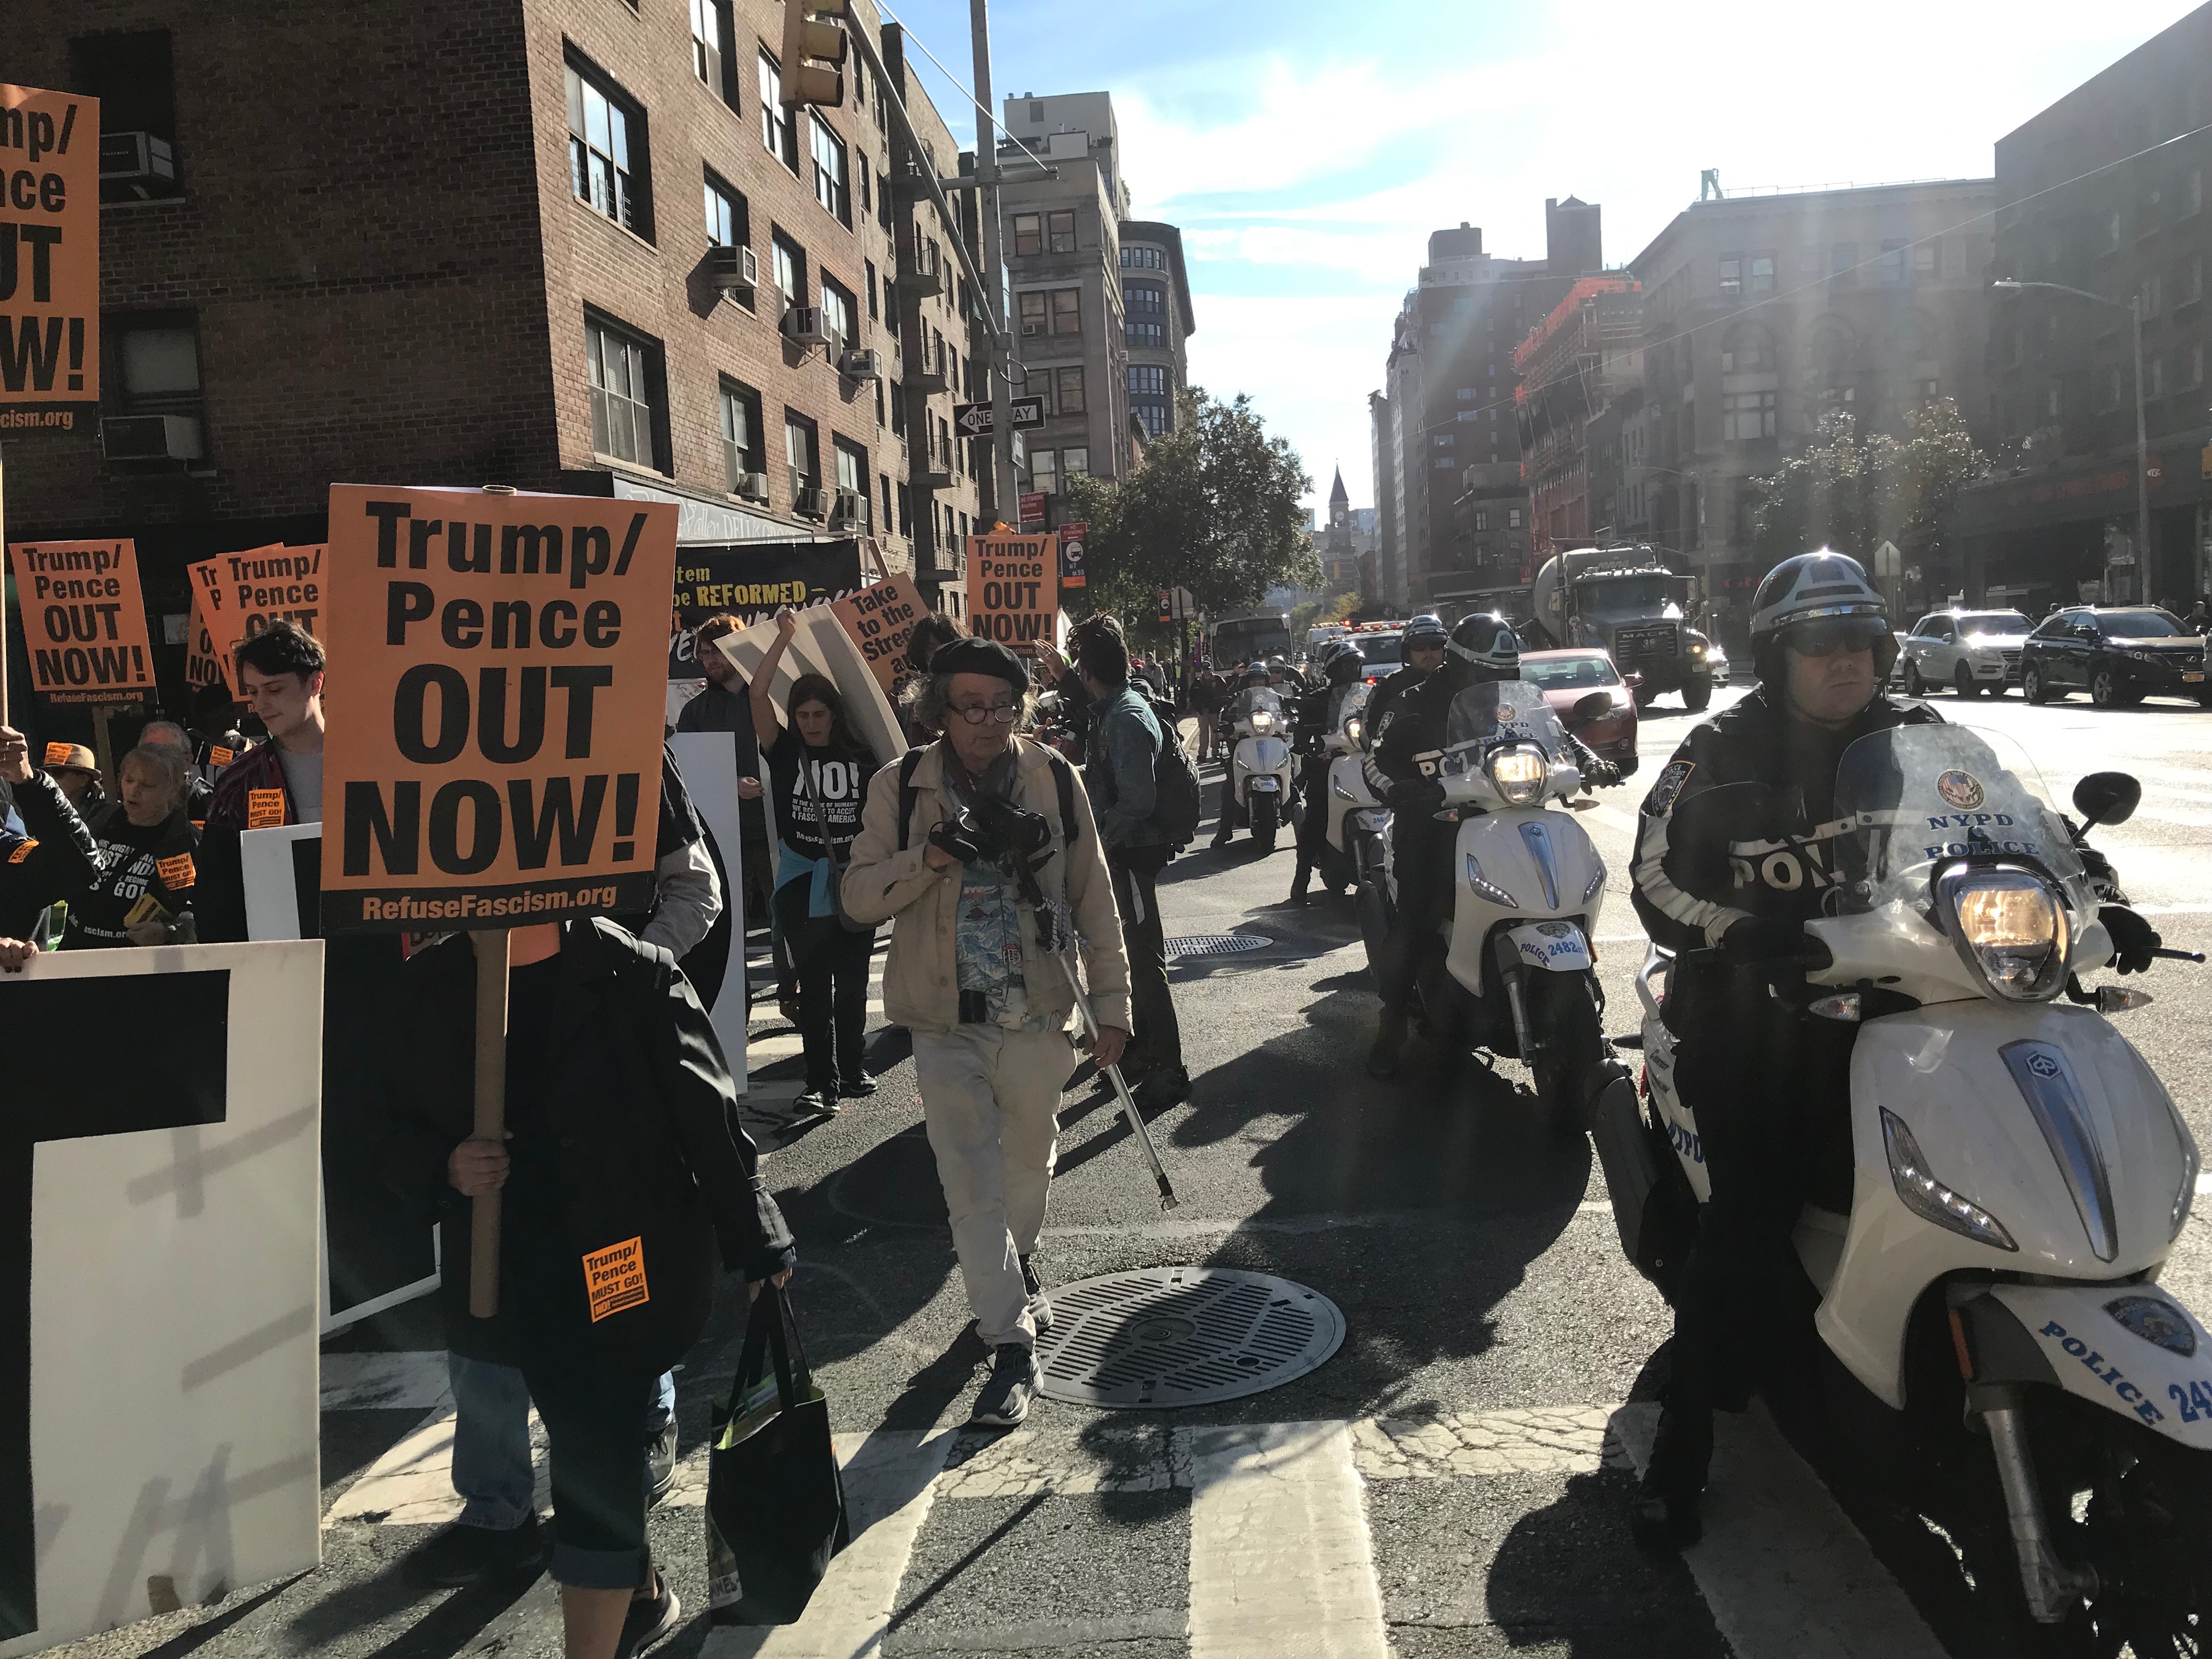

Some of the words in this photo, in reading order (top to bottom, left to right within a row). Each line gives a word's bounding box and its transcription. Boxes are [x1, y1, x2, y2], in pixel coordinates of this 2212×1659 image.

[0, 104, 78, 163] mp/
[0, 315, 84, 392] W!
[968, 412, 992, 426] ONE
[1014, 407, 1031, 421] AY
[366, 501, 648, 589] Trump/
[975, 538, 1048, 561] Trump/
[22, 544, 121, 574] Trump/
[228, 549, 321, 581] Trump/
[981, 560, 1042, 578] Pence
[35, 576, 121, 599] Pence
[676, 566, 710, 584] tem
[238, 584, 318, 609] Pence
[696, 580, 806, 607] REFORMED
[849, 585, 899, 616] Take
[984, 582, 1041, 610] OUT
[44, 603, 121, 642] OUT
[246, 608, 318, 636] OT
[386, 581, 622, 649] Pence
[856, 619, 881, 639] to
[881, 603, 914, 627] the
[973, 614, 1051, 642] NOW!
[862, 620, 914, 661] Stree
[35, 646, 146, 685] NOW!
[189, 655, 219, 685] NO
[50, 691, 144, 703] RefuseFascism.org
[393, 663, 613, 765] OUT
[1488, 722, 1529, 732] NYPD
[1484, 732, 1539, 746] POLICE
[250, 791, 281, 800] Trump/
[252, 800, 280, 809] Pence
[250, 810, 267, 818] MUST
[343, 772, 640, 877] NOW!
[827, 815, 856, 823] AMERICA
[1927, 814, 2013, 830] NYPD
[99, 849, 123, 867] UST
[124, 857, 156, 876] ND!
[157, 855, 189, 868] Trump/
[1923, 841, 2040, 860] POLICE
[162, 864, 189, 875] Pence
[114, 882, 146, 899] GO!
[363, 884, 617, 921] RefuseFascism.org
[1520, 943, 1550, 967] POLICE
[586, 1240, 637, 1271] Trump/
[592, 1261, 636, 1285] Pence
[592, 1281, 620, 1302] MUST
[624, 1273, 643, 1288] GO!
[2039, 1321, 2165, 1426] POLICE
